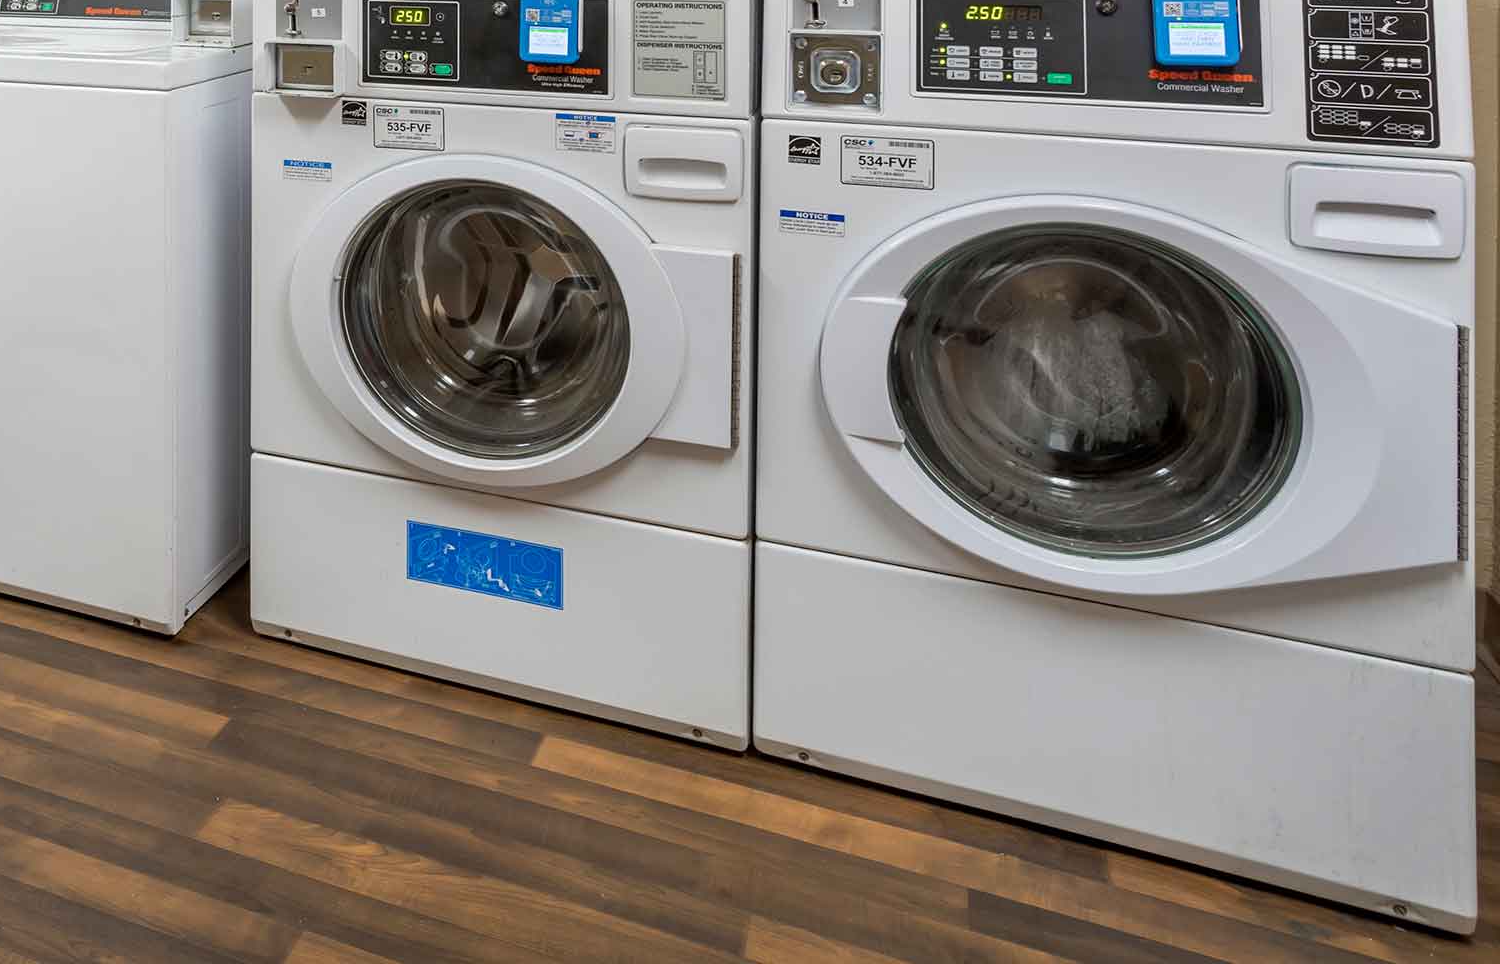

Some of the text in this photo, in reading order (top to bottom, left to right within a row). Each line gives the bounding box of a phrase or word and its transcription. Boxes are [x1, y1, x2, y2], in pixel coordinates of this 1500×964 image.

[965, 5, 1004, 20] 2.50
[527, 64, 601, 76] Speed Queen
[1148, 68, 1253, 83] Speed Queen
[532, 74, 594, 84] Commercial Washer
[1156, 82, 1244, 93] Commercial Washer
[387, 122, 432, 133] 535-FVF
[844, 138, 867, 146] CSC
[858, 155, 917, 169] 534-FVF
[795, 211, 829, 221] NOTICE
